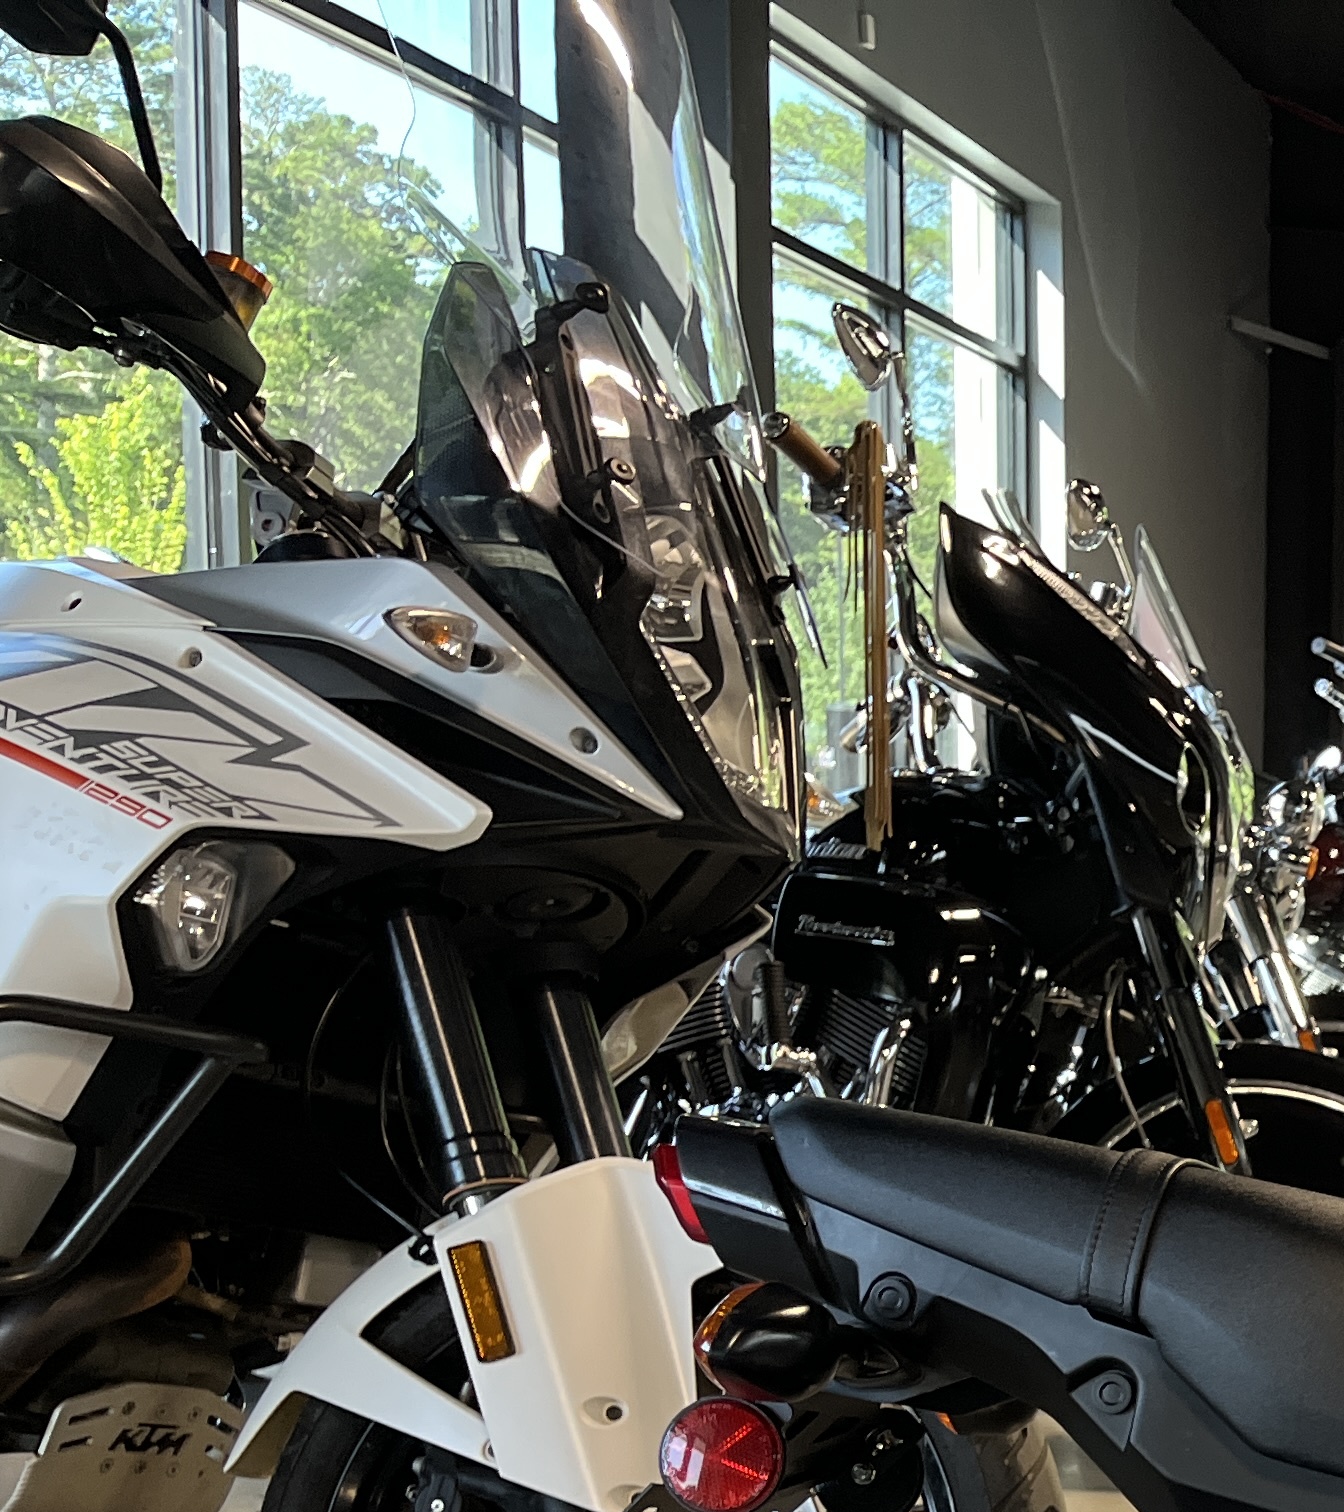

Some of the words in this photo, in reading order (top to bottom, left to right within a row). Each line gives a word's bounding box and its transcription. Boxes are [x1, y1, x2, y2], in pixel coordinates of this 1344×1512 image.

[0, 703, 217, 819] VENTURE
[99, 739, 262, 819] SUPER
[77, 778, 174, 830] 1290
[108, 1422, 193, 1457] KTM
